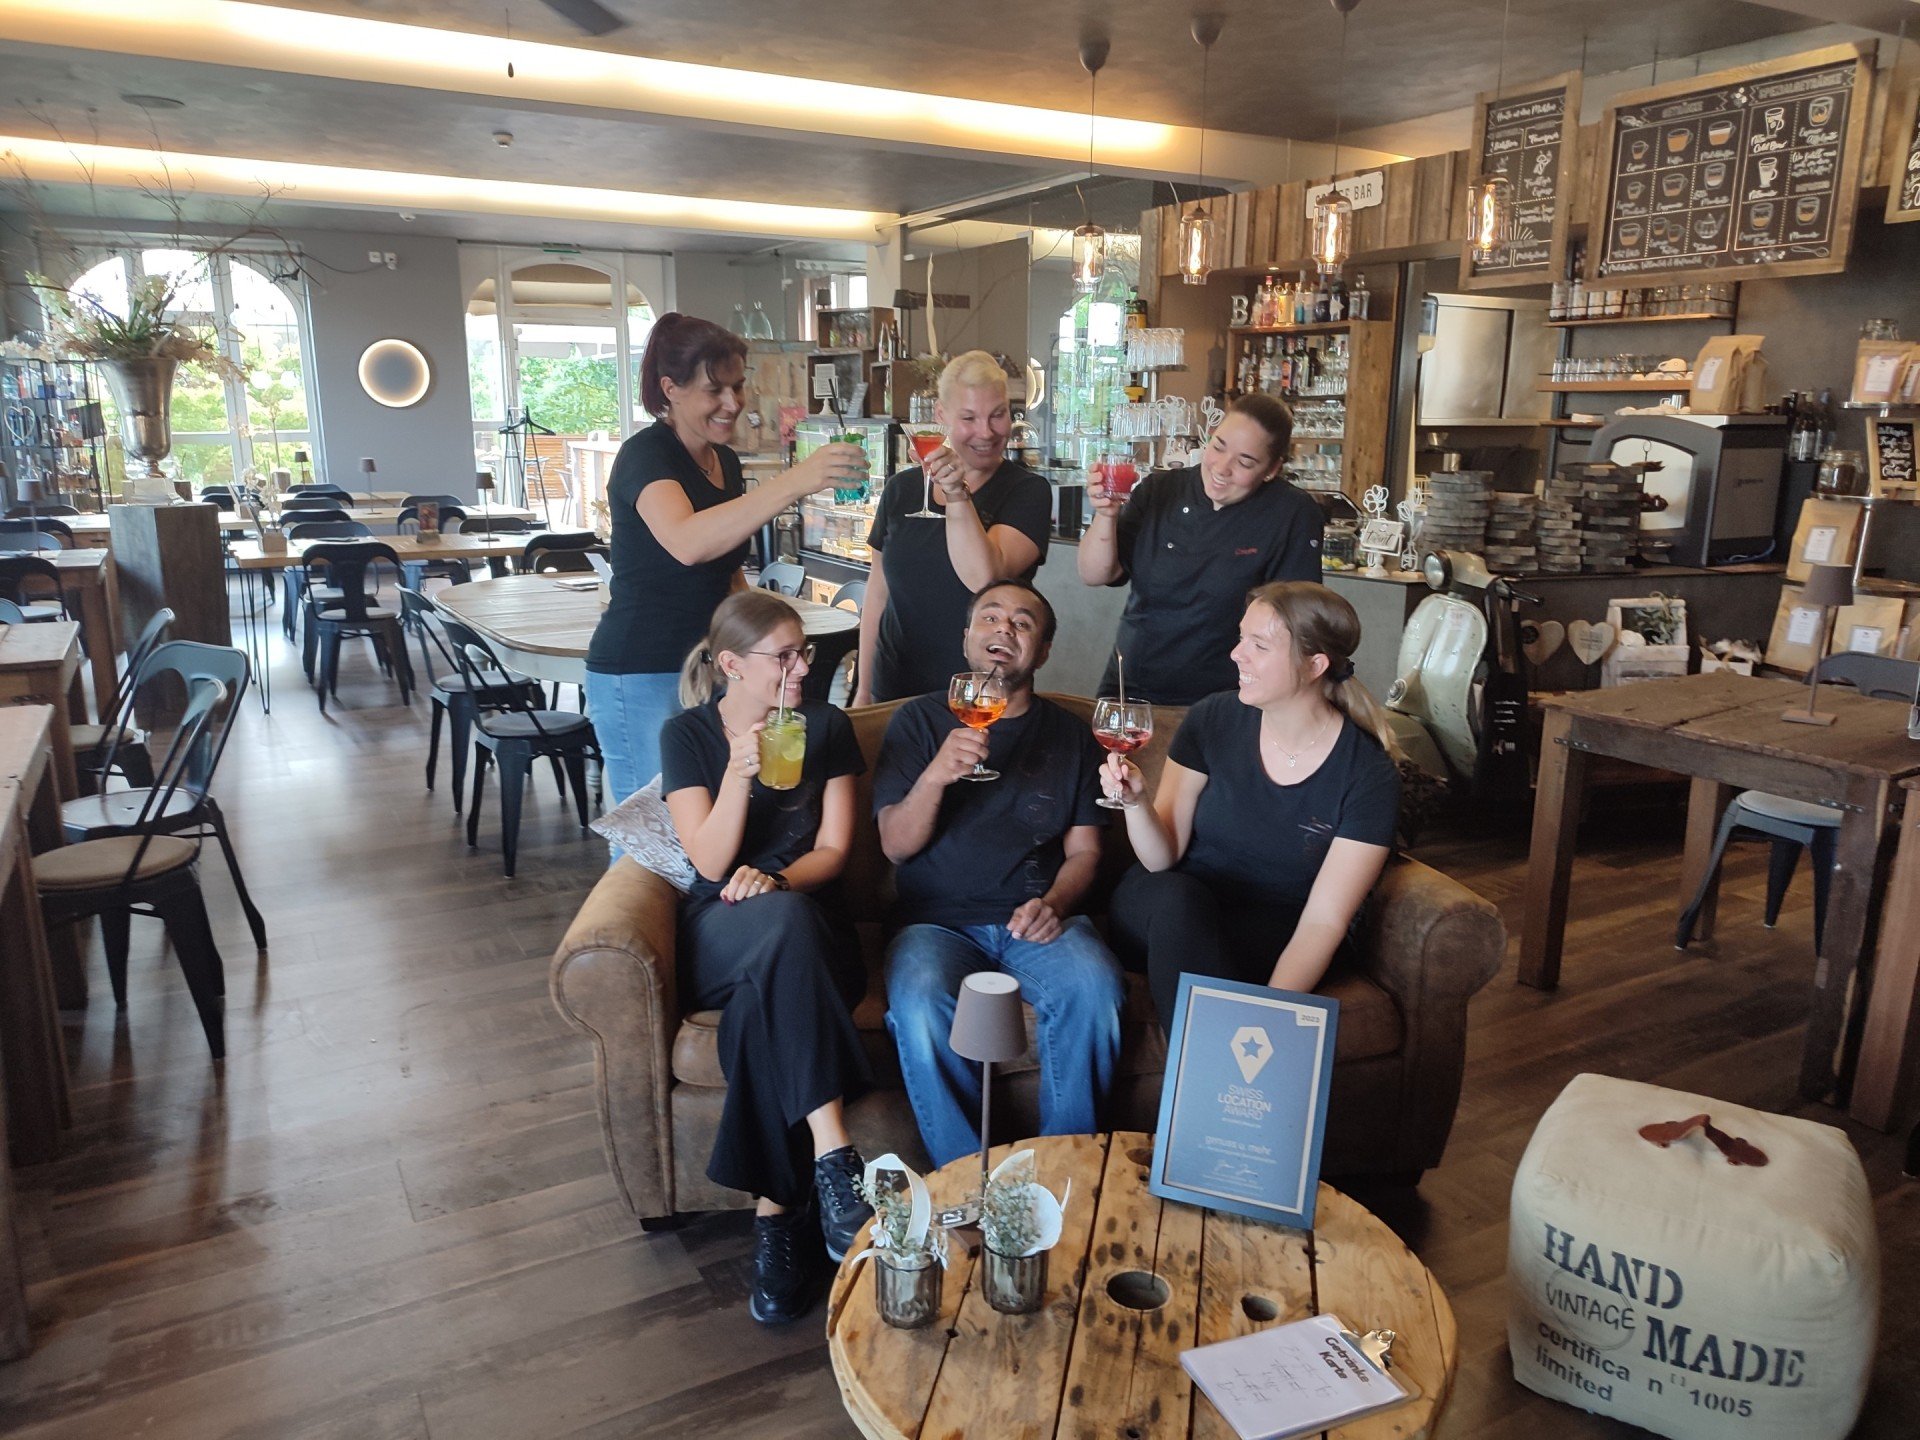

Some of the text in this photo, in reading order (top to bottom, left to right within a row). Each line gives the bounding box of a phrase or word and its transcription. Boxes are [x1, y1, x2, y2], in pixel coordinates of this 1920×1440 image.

[1353, 182, 1373, 200] BAR
[1217, 1092, 1272, 1113] LOCATION
[1228, 1084, 1264, 1101] SWISS
[1542, 1222, 1684, 1310] HAND
[1545, 1281, 1637, 1331] VINTAGE
[1318, 1351, 1348, 1379] Karte
[1642, 1315, 1806, 1389] MADE
[1536, 1345, 1613, 1402] limited
[1689, 1388, 1754, 1418] 1005
